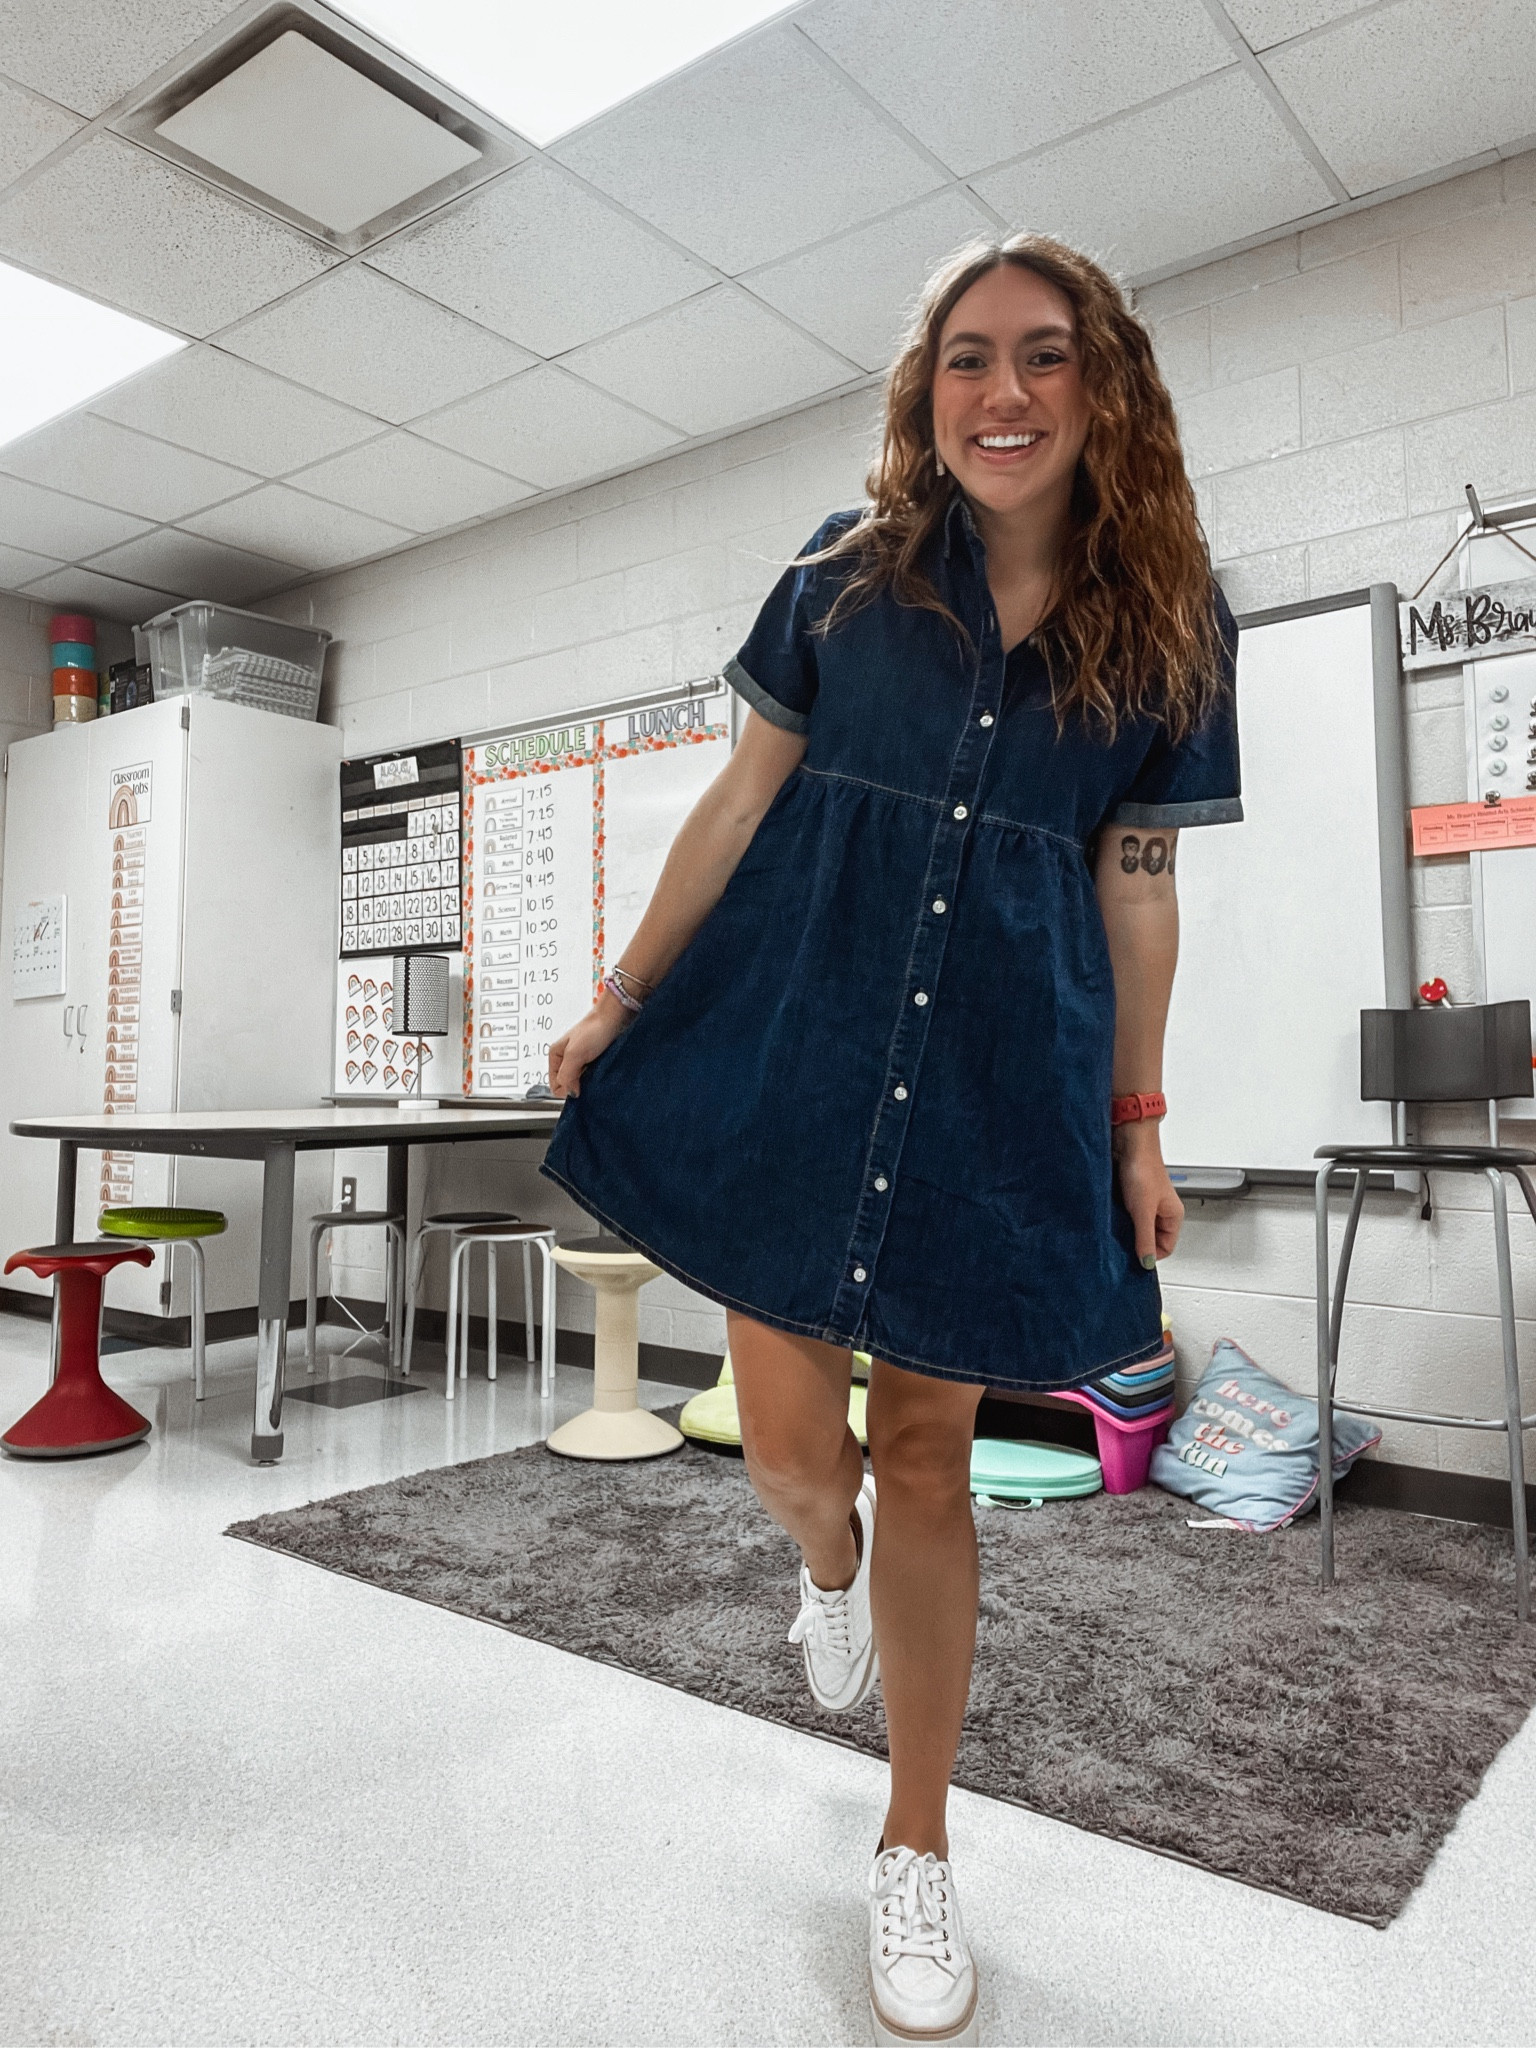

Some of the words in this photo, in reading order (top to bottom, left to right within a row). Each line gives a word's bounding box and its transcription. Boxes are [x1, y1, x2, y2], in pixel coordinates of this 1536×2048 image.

[628, 700, 706, 740] LUNCH
[484, 726, 586, 768] SCHEDULE
[113, 768, 150, 786] Classroom
[130, 782, 149, 797] Jobs
[527, 784, 552, 800] 7:15
[447, 811, 454, 827] 3
[527, 804, 554, 821] 7:25
[527, 826, 553, 844] 7:45
[347, 854, 353, 867] 4
[362, 850, 369, 865] 5
[378, 849, 386, 864] 6
[395, 846, 401, 863] 7
[411, 843, 418, 859] 8
[429, 841, 436, 857] 9
[446, 836, 455, 854] 10
[526, 846, 554, 865] 8:40
[362, 876, 370, 892] 12
[377, 875, 386, 890] 13
[394, 872, 402, 887] 14
[411, 870, 418, 886] 15
[427, 868, 437, 883] 16
[446, 865, 454, 881] 17
[526, 871, 554, 888] 9:45
[346, 905, 354, 921] 18
[362, 903, 370, 919] 19
[376, 900, 387, 918] 20
[392, 900, 401, 916] 21
[407, 897, 420, 914] 22
[425, 896, 438, 913] 23
[444, 894, 457, 910] 24
[527, 895, 554, 912] 10:15
[345, 930, 356, 946] 25
[360, 929, 372, 945] 26
[376, 928, 387, 944] 27
[391, 925, 403, 942] 28
[408, 924, 420, 941] 29
[426, 921, 439, 939] 30
[446, 920, 456, 937] 31
[526, 941, 557, 958] 11:55
[524, 967, 559, 987] 12:25
[524, 993, 553, 1008] 1:00
[524, 1015, 553, 1032] 1:40
[524, 1042, 551, 1058] 2:10
[1215, 1380, 1292, 1429] here
[1193, 1398, 1289, 1451] comes
[1193, 1423, 1246, 1454] the
[1178, 1441, 1228, 1479] fun
